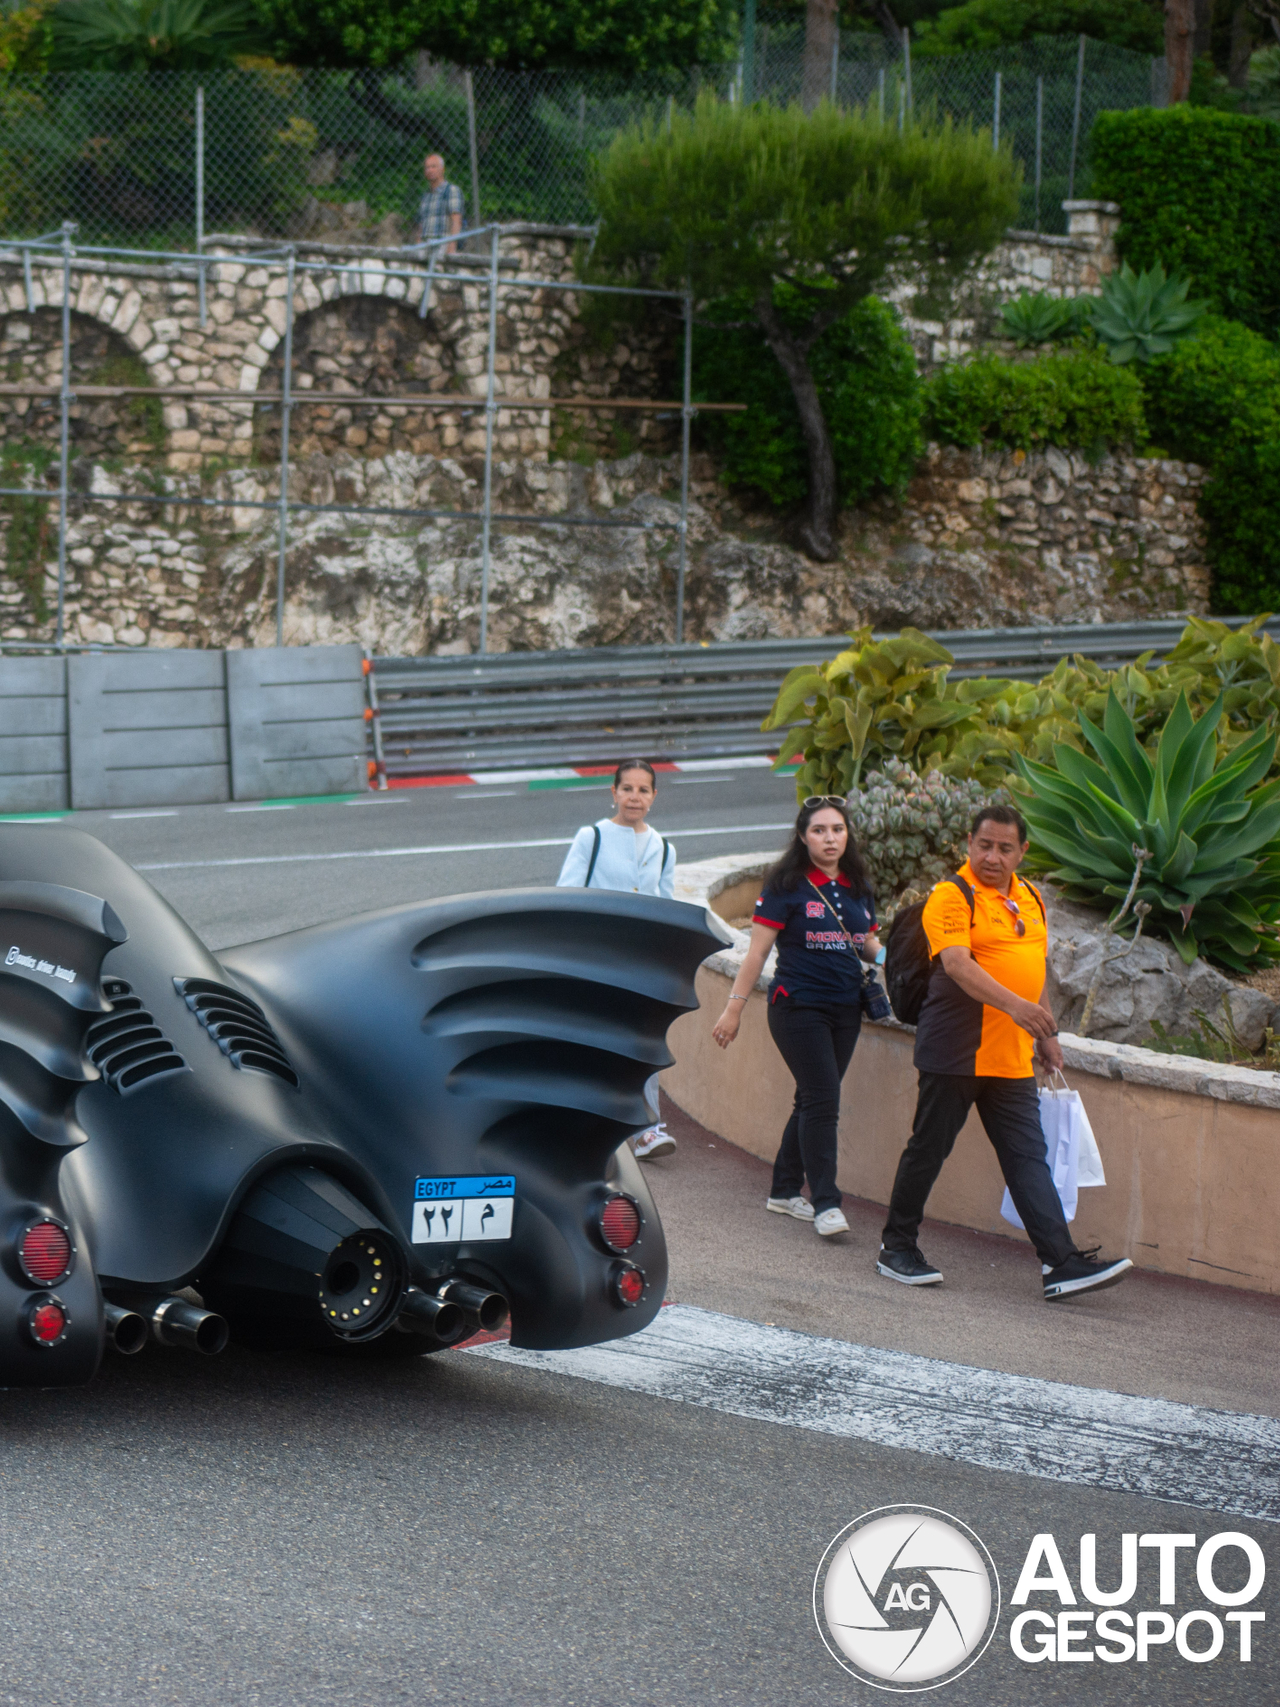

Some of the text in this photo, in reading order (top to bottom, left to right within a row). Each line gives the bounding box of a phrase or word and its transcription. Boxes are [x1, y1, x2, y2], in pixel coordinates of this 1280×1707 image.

[806, 931, 869, 943] MONAC
[806, 942, 847, 950] GRAND
[418, 1181, 456, 1196] EGYPT
[476, 1179, 512, 1194] مصر
[480, 1203, 495, 1235] م
